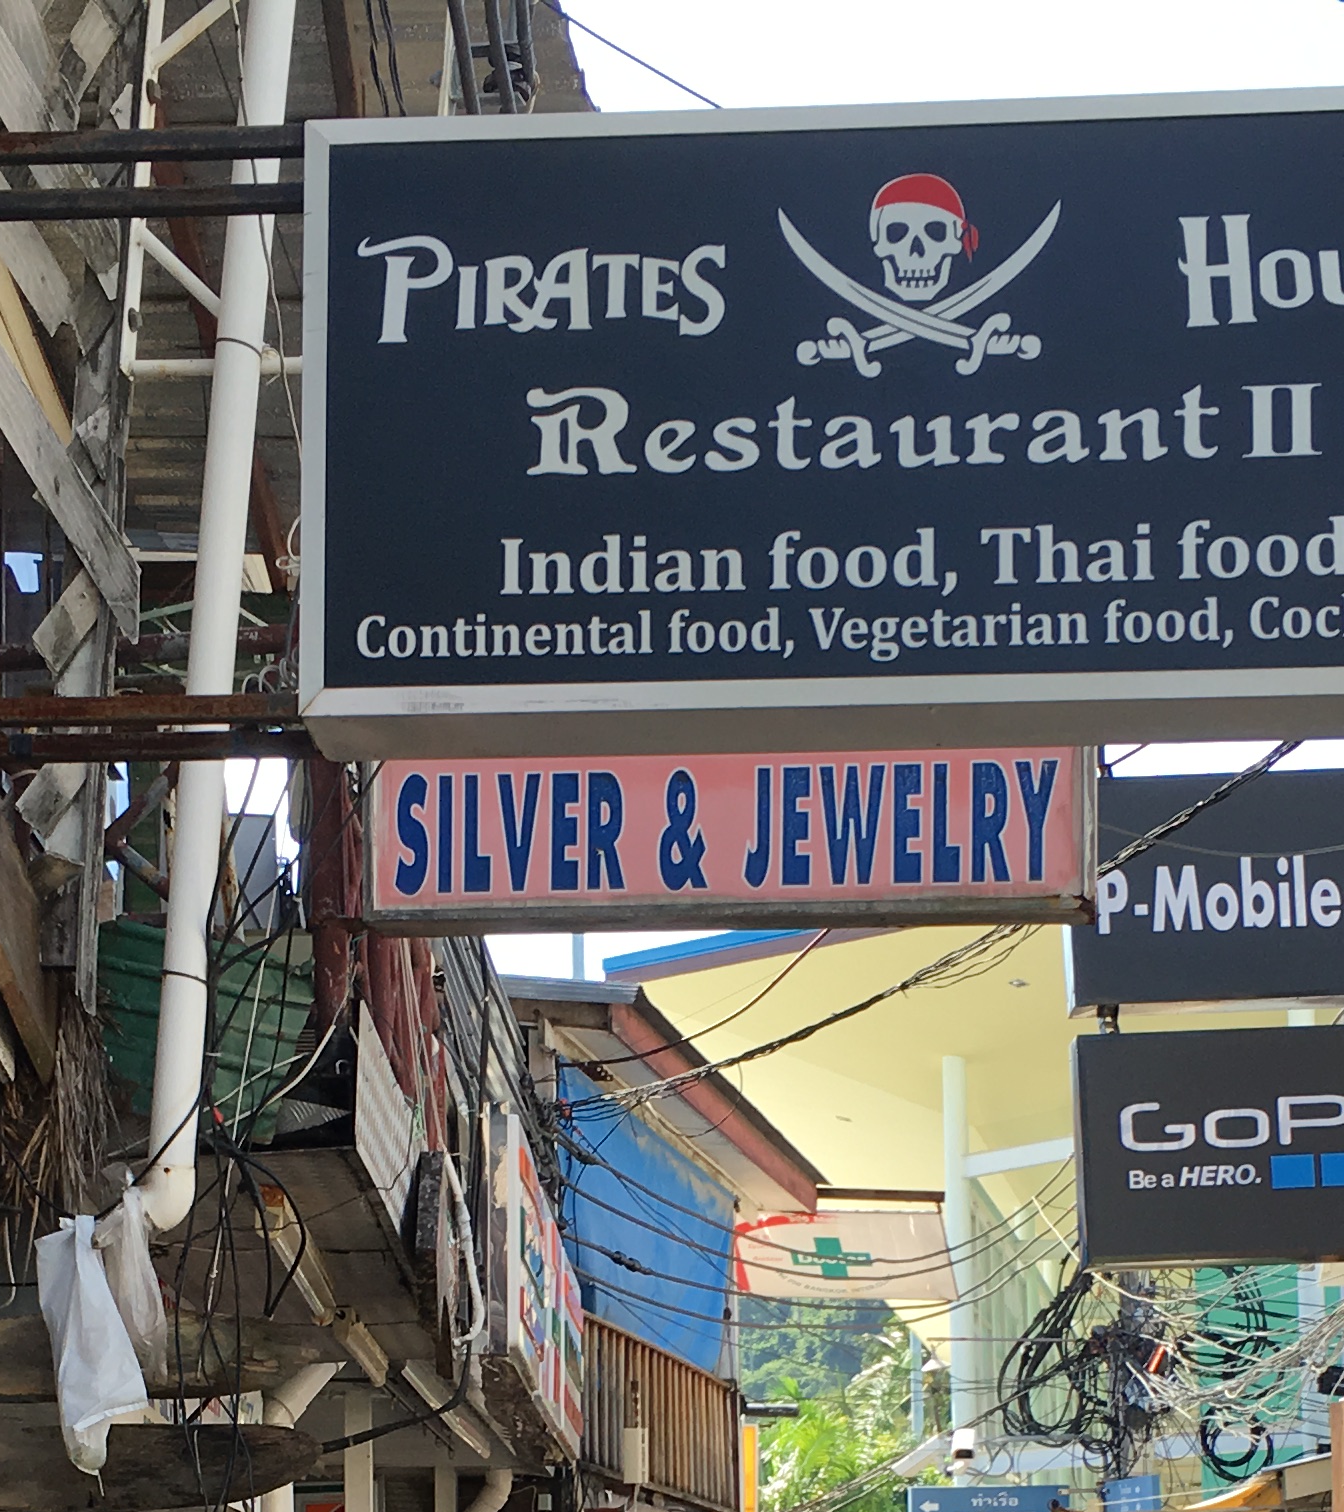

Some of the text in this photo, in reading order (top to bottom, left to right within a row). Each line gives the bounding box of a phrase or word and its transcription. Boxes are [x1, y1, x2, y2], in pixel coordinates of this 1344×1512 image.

[358, 236, 725, 343] PIRATES
[527, 383, 1322, 475] Restaurant II
[501, 536, 746, 594] Indian
[769, 528, 957, 596] food,
[981, 524, 1154, 584] Thai
[358, 609, 652, 657] Continental
[669, 608, 794, 658] food,
[809, 607, 1089, 661] Vegetarian
[1104, 597, 1233, 647] food,
[394, 757, 1061, 897] SILVER & JEWELRY
[1097, 854, 1342, 935] P-Mobile
[1129, 1164, 1263, 1190] Be a HERO.
